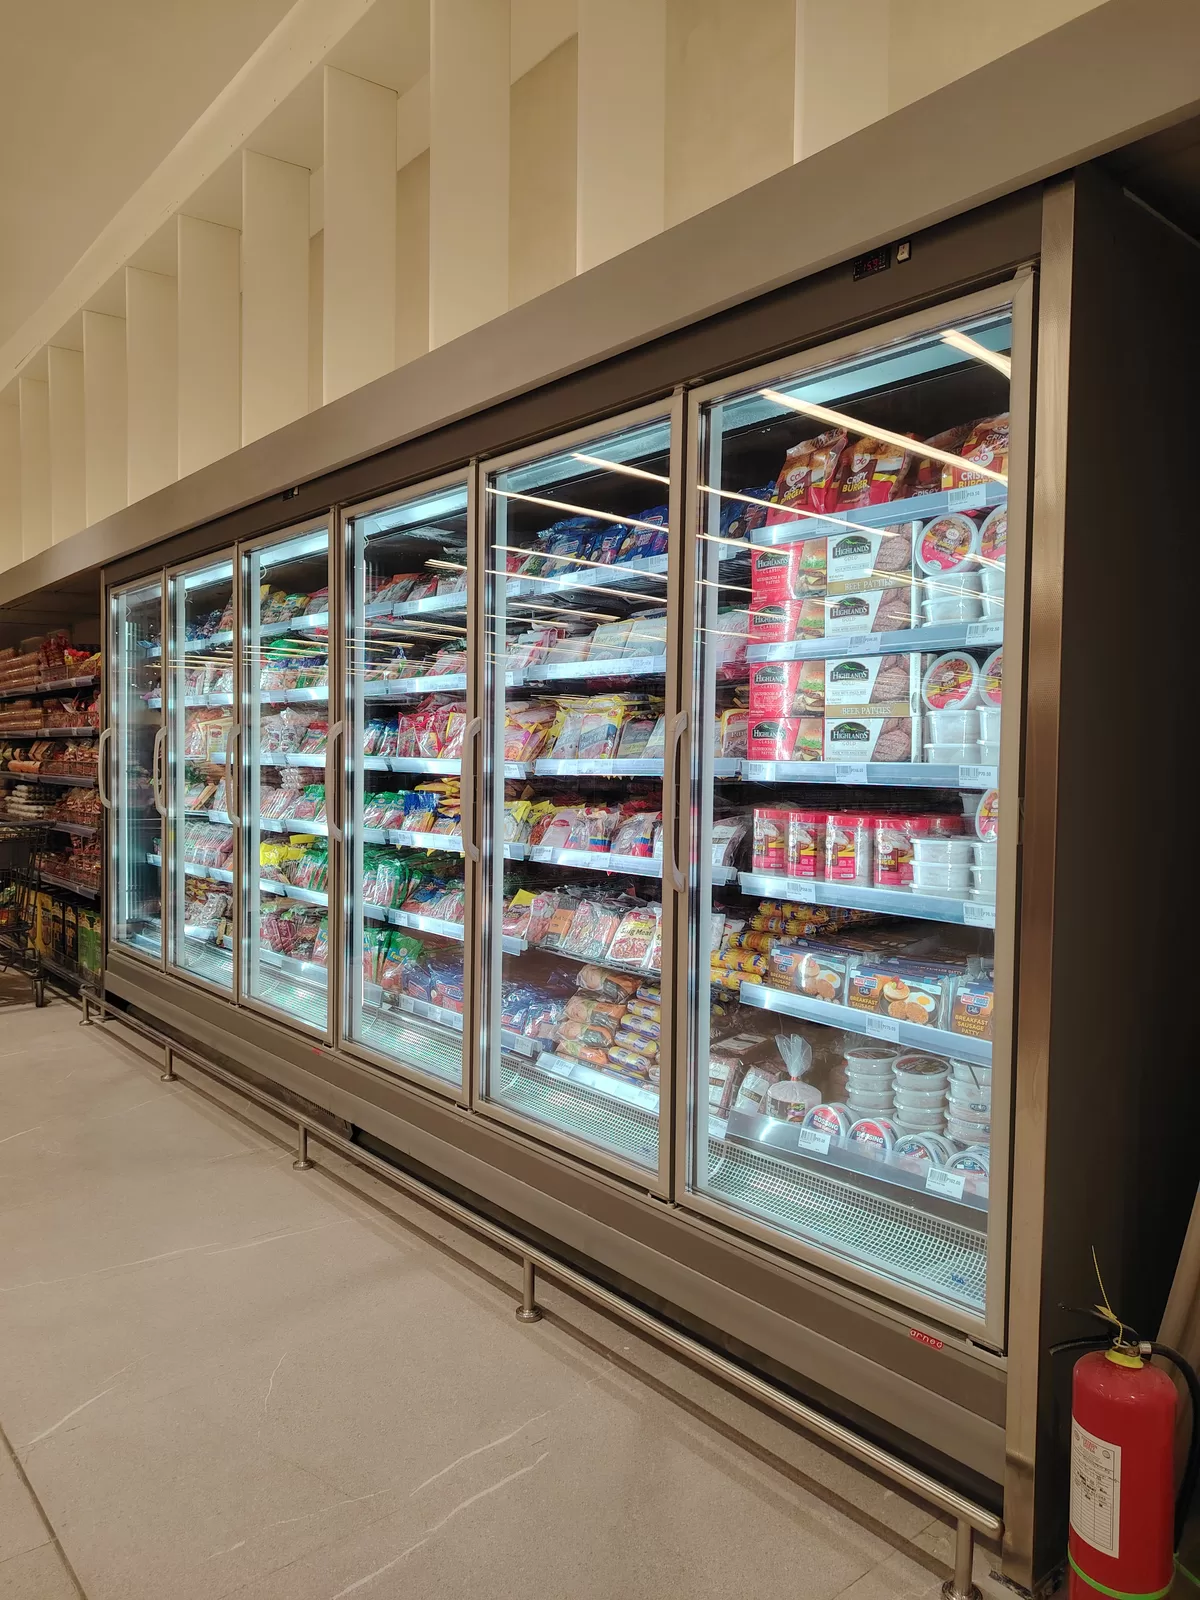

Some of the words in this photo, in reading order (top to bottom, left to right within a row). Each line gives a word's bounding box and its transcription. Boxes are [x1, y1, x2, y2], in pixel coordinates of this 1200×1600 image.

[842, 479, 868, 493] BURGER
[835, 543, 870, 557] HIGHLANDS
[757, 555, 789, 569] HIGHLANDS
[845, 582, 861, 591] BEEF
[863, 579, 893, 588] PATTIES
[832, 605, 868, 617] HIGHLANDS
[756, 674, 788, 683] HIGHLAN
[832, 670, 869, 680] HIGHLANDS
[842, 707, 860, 715] BEEF
[832, 731, 869, 740] HIGHLANDS
[771, 971, 793, 981] BREAKFAST
[850, 995, 878, 1006] BREAKFAST
[955, 1014, 988, 1026] BREAKFAST
[957, 1021, 985, 1032] SAUSAGE
[961, 1028, 980, 1036] PATTY
